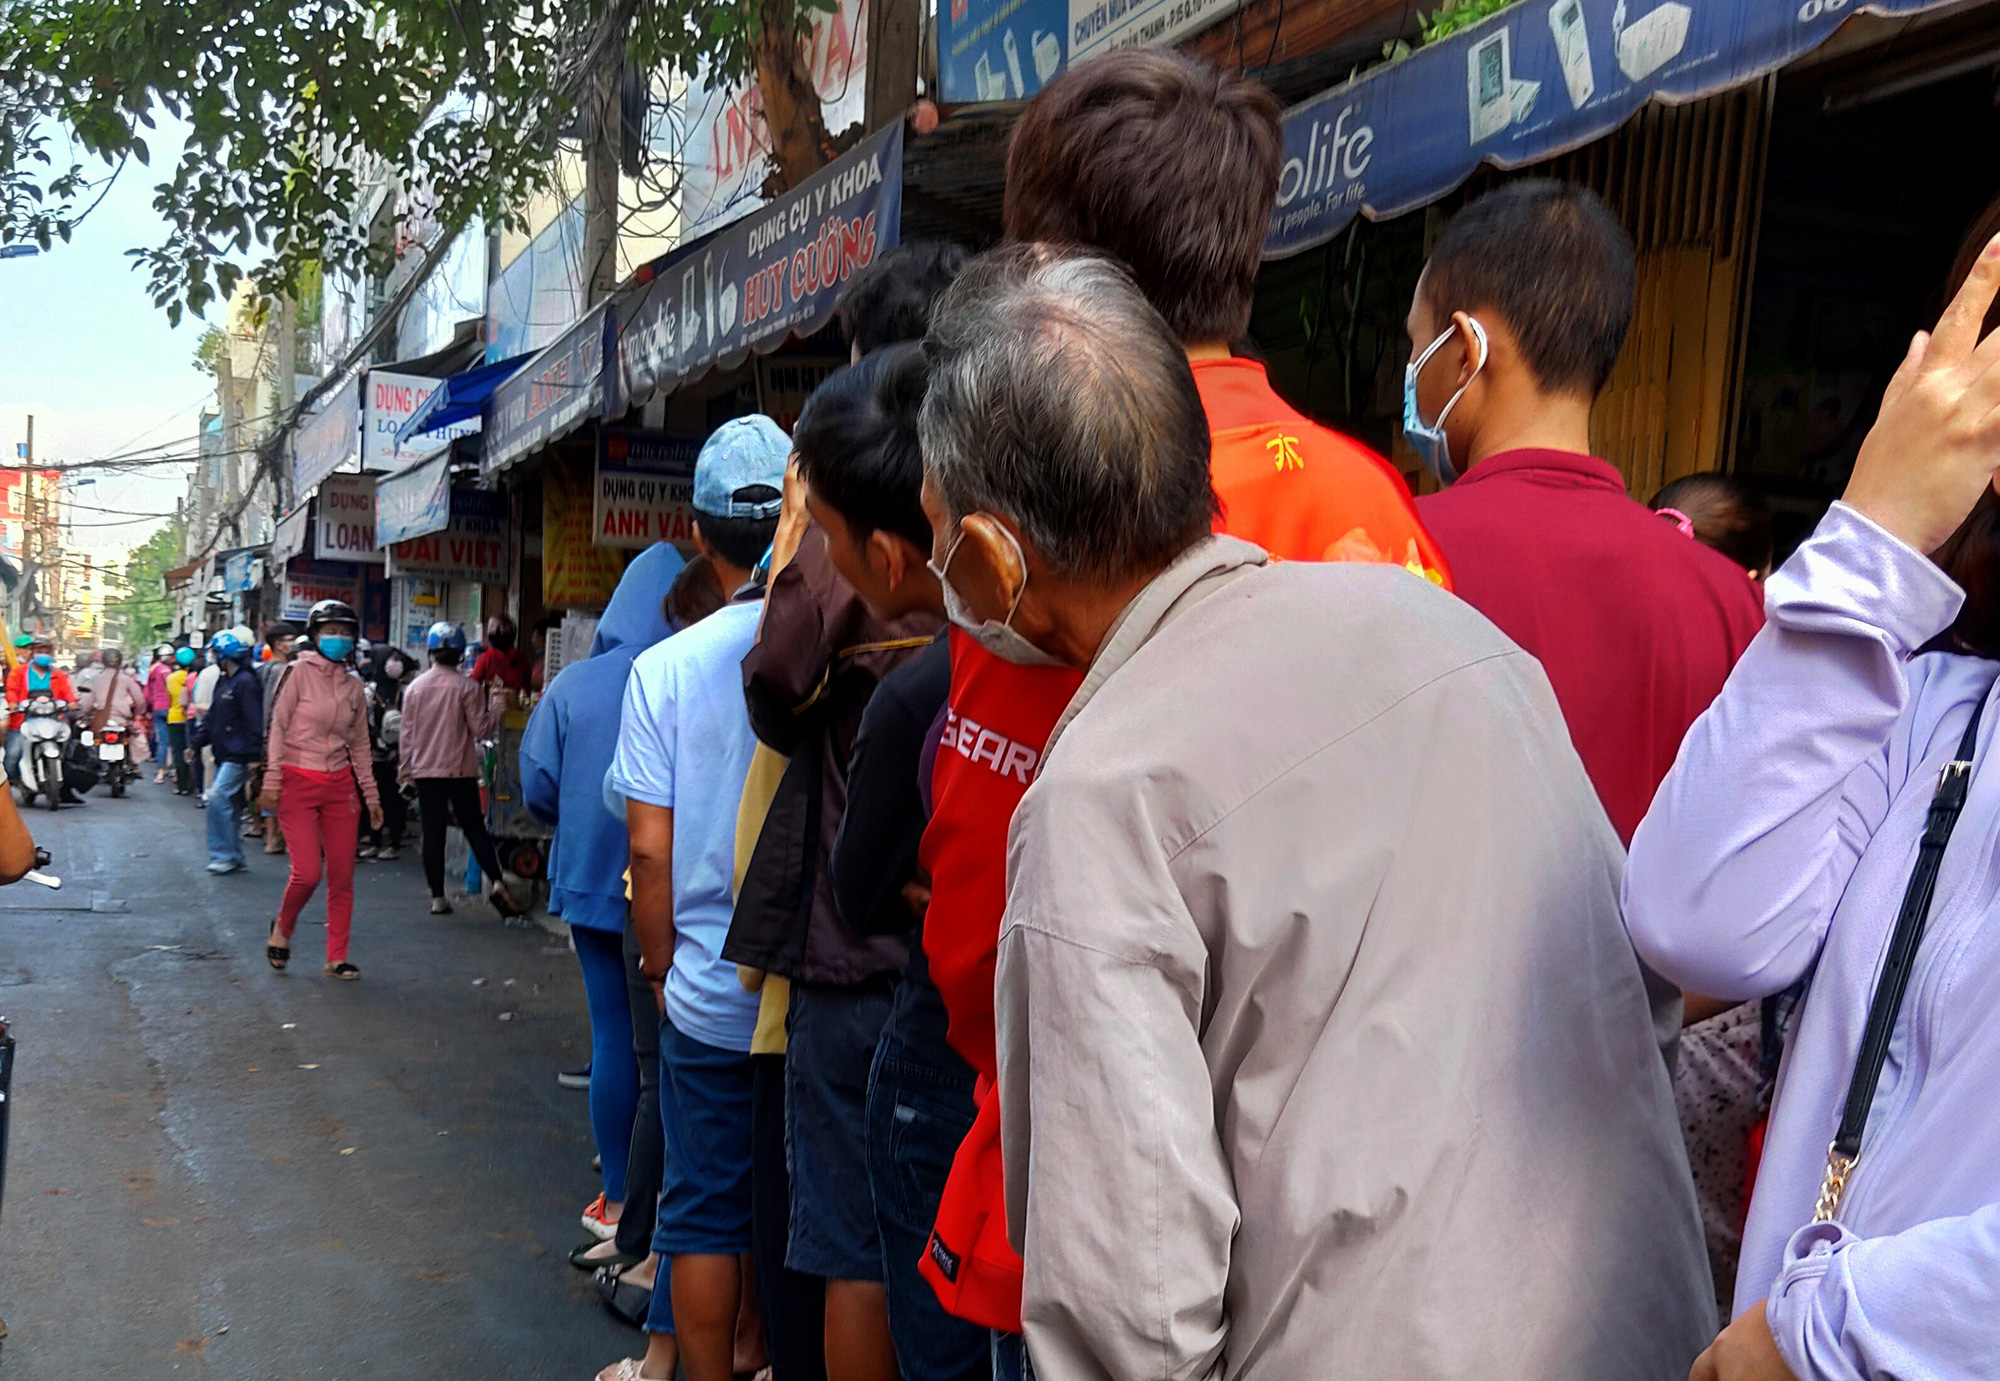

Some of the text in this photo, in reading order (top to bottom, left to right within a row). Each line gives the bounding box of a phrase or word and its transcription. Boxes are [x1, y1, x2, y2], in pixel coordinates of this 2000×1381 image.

[748, 210, 787, 260] DỤNG
[789, 194, 811, 235] CỤ
[815, 184, 826, 217] Y
[830, 152, 882, 210] KHOA
[1283, 199, 1322, 237] people.
[1325, 191, 1344, 214] For
[743, 256, 788, 328] HUY
[790, 209, 876, 303] CƯỜNG
[376, 384, 411, 417] DỤNG
[603, 480, 694, 505] DỤNG CỤ Y KHO
[325, 522, 376, 552] LOAN
[603, 508, 649, 538] ANH
